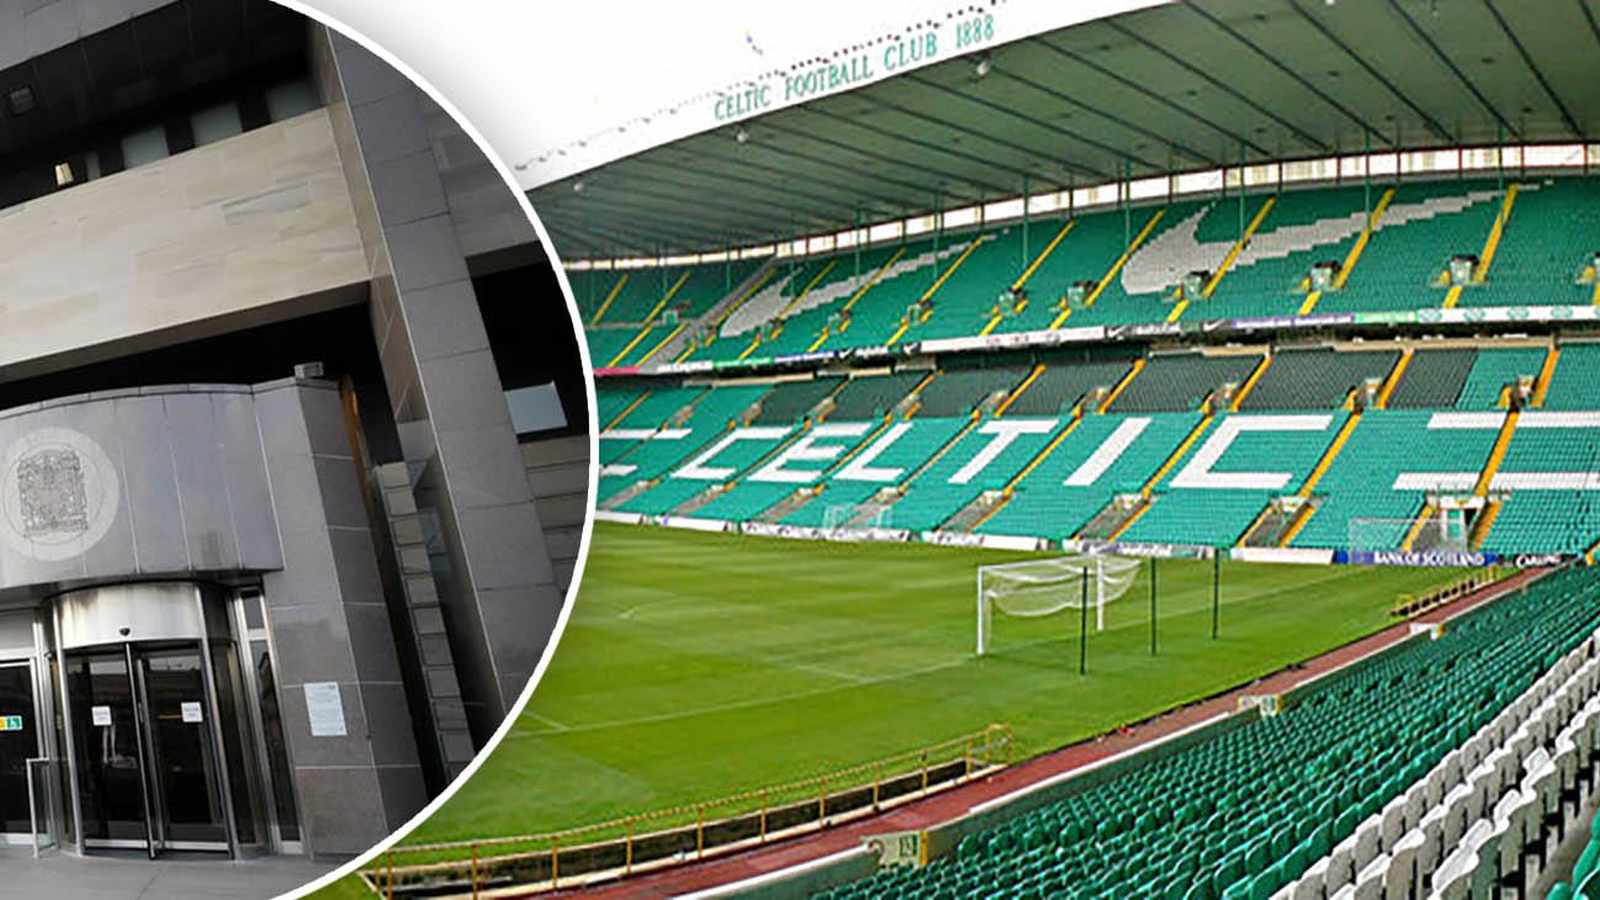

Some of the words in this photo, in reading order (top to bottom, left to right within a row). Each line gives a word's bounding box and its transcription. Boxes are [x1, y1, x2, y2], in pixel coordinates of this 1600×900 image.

[714, 84, 772, 120] CELTIC
[784, 54, 874, 101] FOOTBALL
[883, 31, 937, 70] CLUB
[956, 14, 994, 49] 1888
[670, 415, 1333, 489] CELTIC
[1374, 551, 1406, 564] BANK
[1405, 551, 1420, 565] OF
[1422, 551, 1485, 566] SCOTLAND
